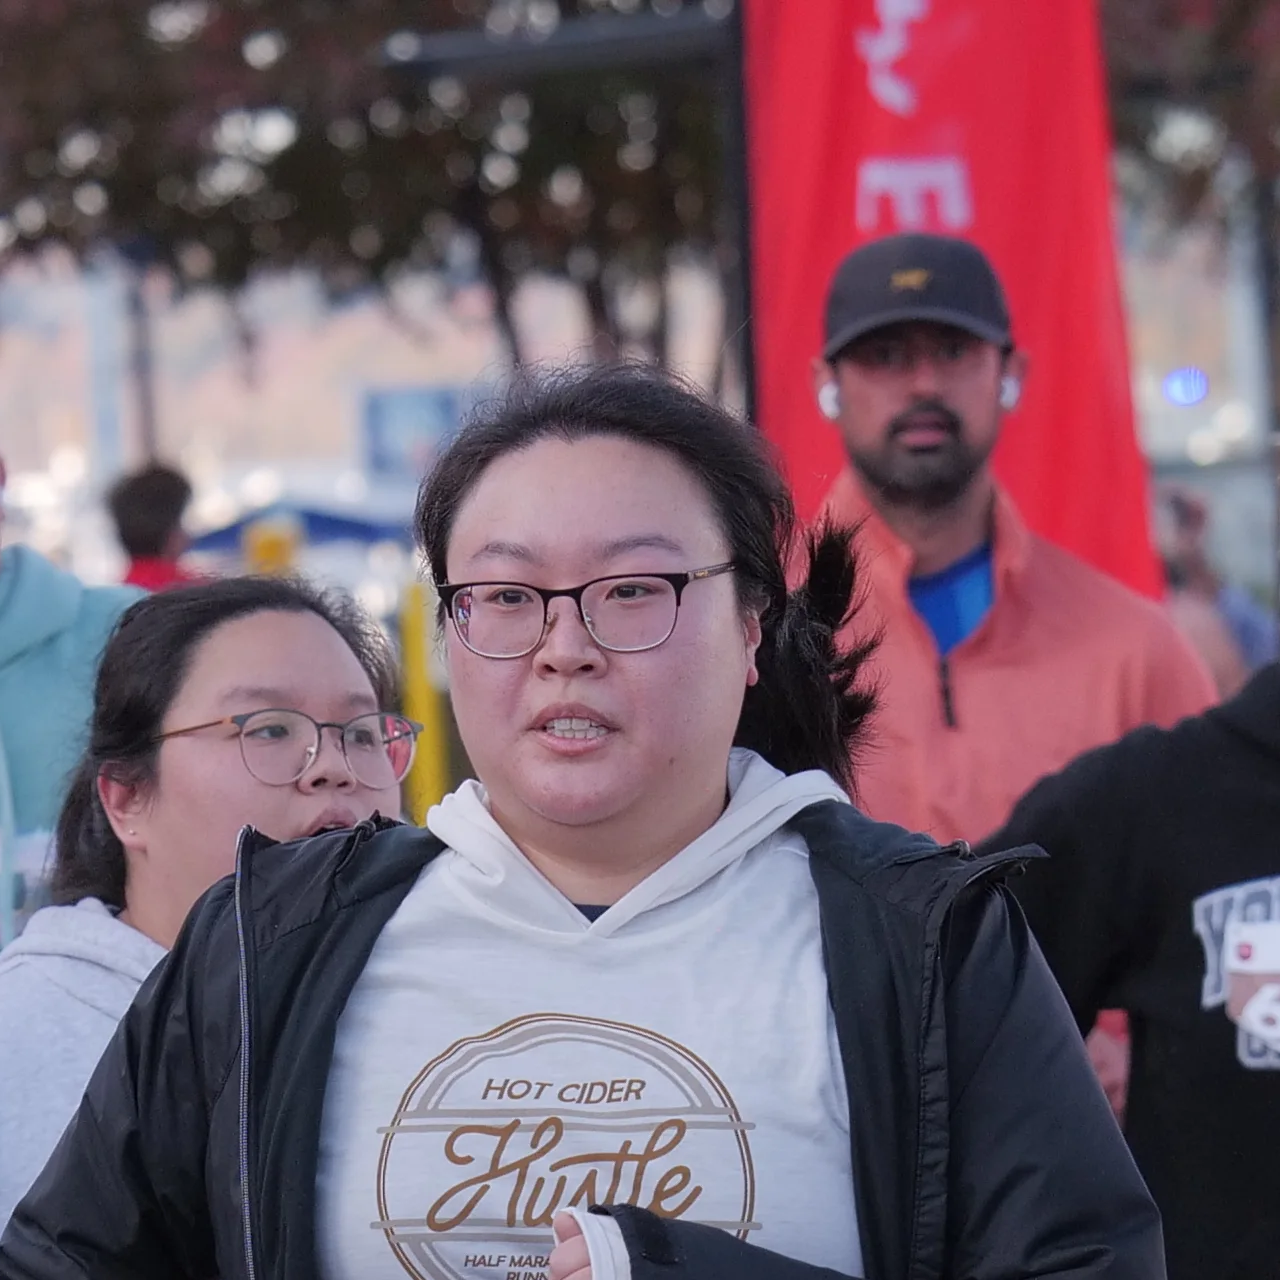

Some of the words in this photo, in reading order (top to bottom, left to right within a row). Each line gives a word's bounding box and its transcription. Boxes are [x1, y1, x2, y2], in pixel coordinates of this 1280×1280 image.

[481, 1078, 553, 1101] HOT
[557, 1078, 646, 1105] CIDER
[425, 1116, 703, 1232] Hustle
[463, 1254, 507, 1268] HALF
[508, 1254, 551, 1268] MARA
